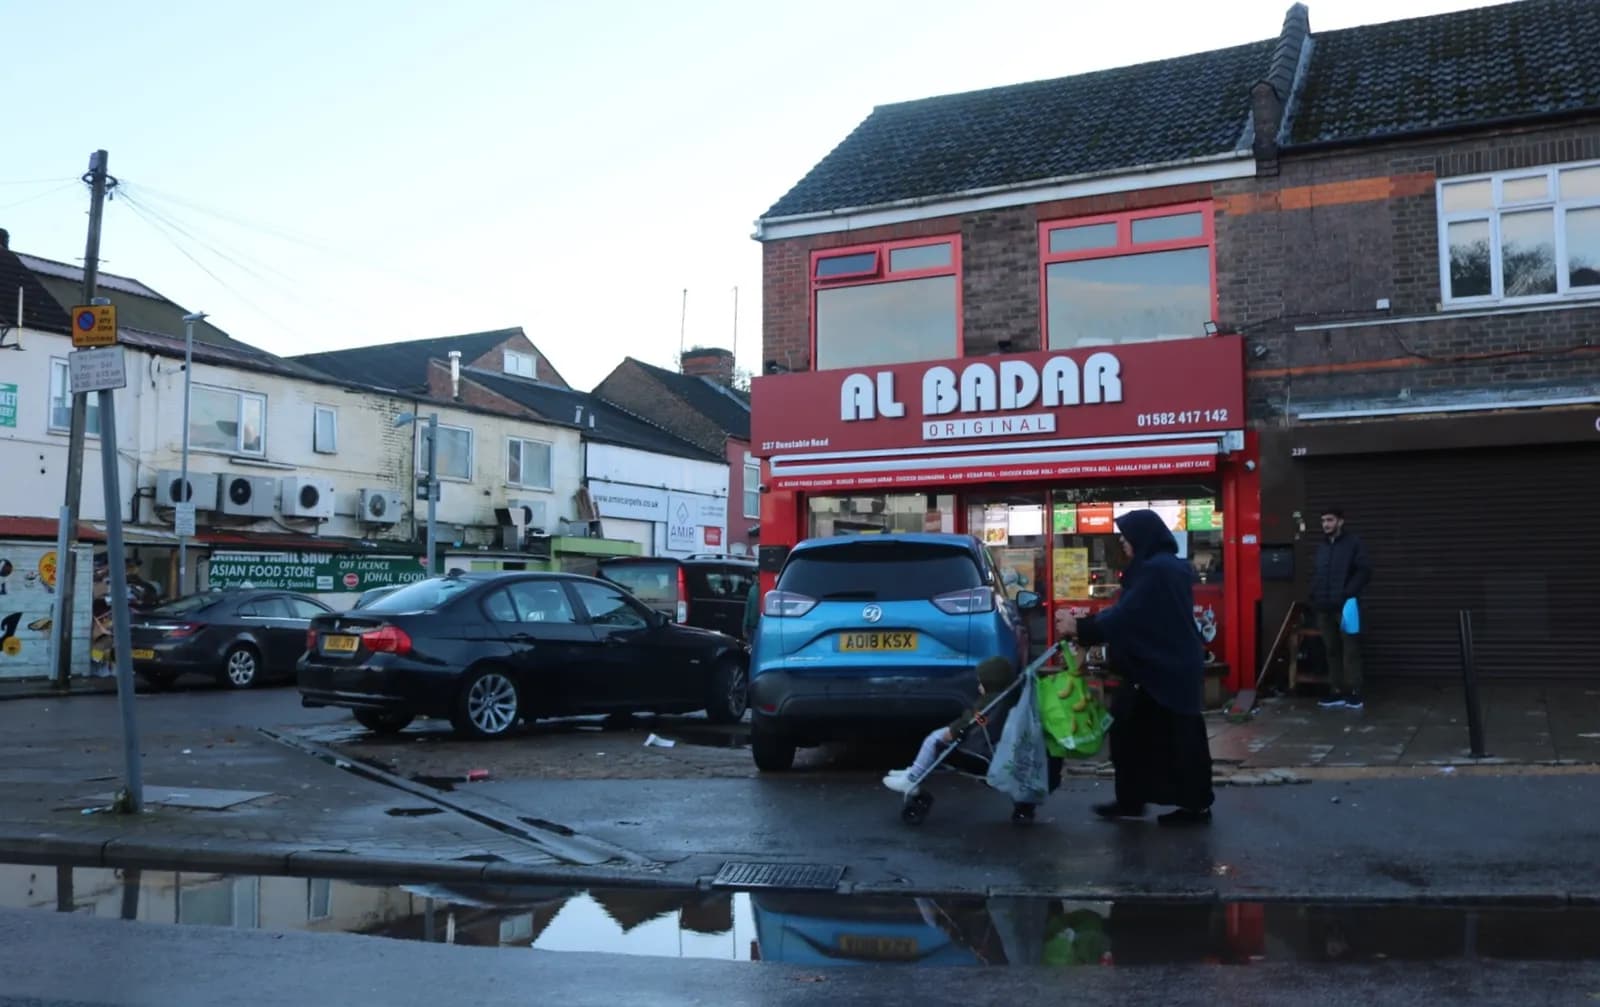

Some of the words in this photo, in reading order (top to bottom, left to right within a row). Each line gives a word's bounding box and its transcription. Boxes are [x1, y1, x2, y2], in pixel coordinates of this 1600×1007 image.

[841, 371, 905, 421] AL
[922, 352, 1123, 416] BADAR
[1137, 412, 1176, 427] 01582
[1178, 410, 1201, 424] 417
[1204, 408, 1228, 422] 142
[929, 419, 1047, 437] ORIGINAL
[775, 439, 810, 449] Dunstable
[811, 438, 829, 447] Road
[1175, 461, 1194, 469] SWEET
[670, 525, 695, 539] AMIR
[210, 564, 247, 577] ASIAN
[248, 564, 281, 577] FOOD
[283, 565, 316, 578] STORE
[339, 560, 355, 570] OFF
[357, 561, 390, 570] LICENCE
[363, 571, 393, 583] JOHAL
[882, 633, 913, 649] KSX
